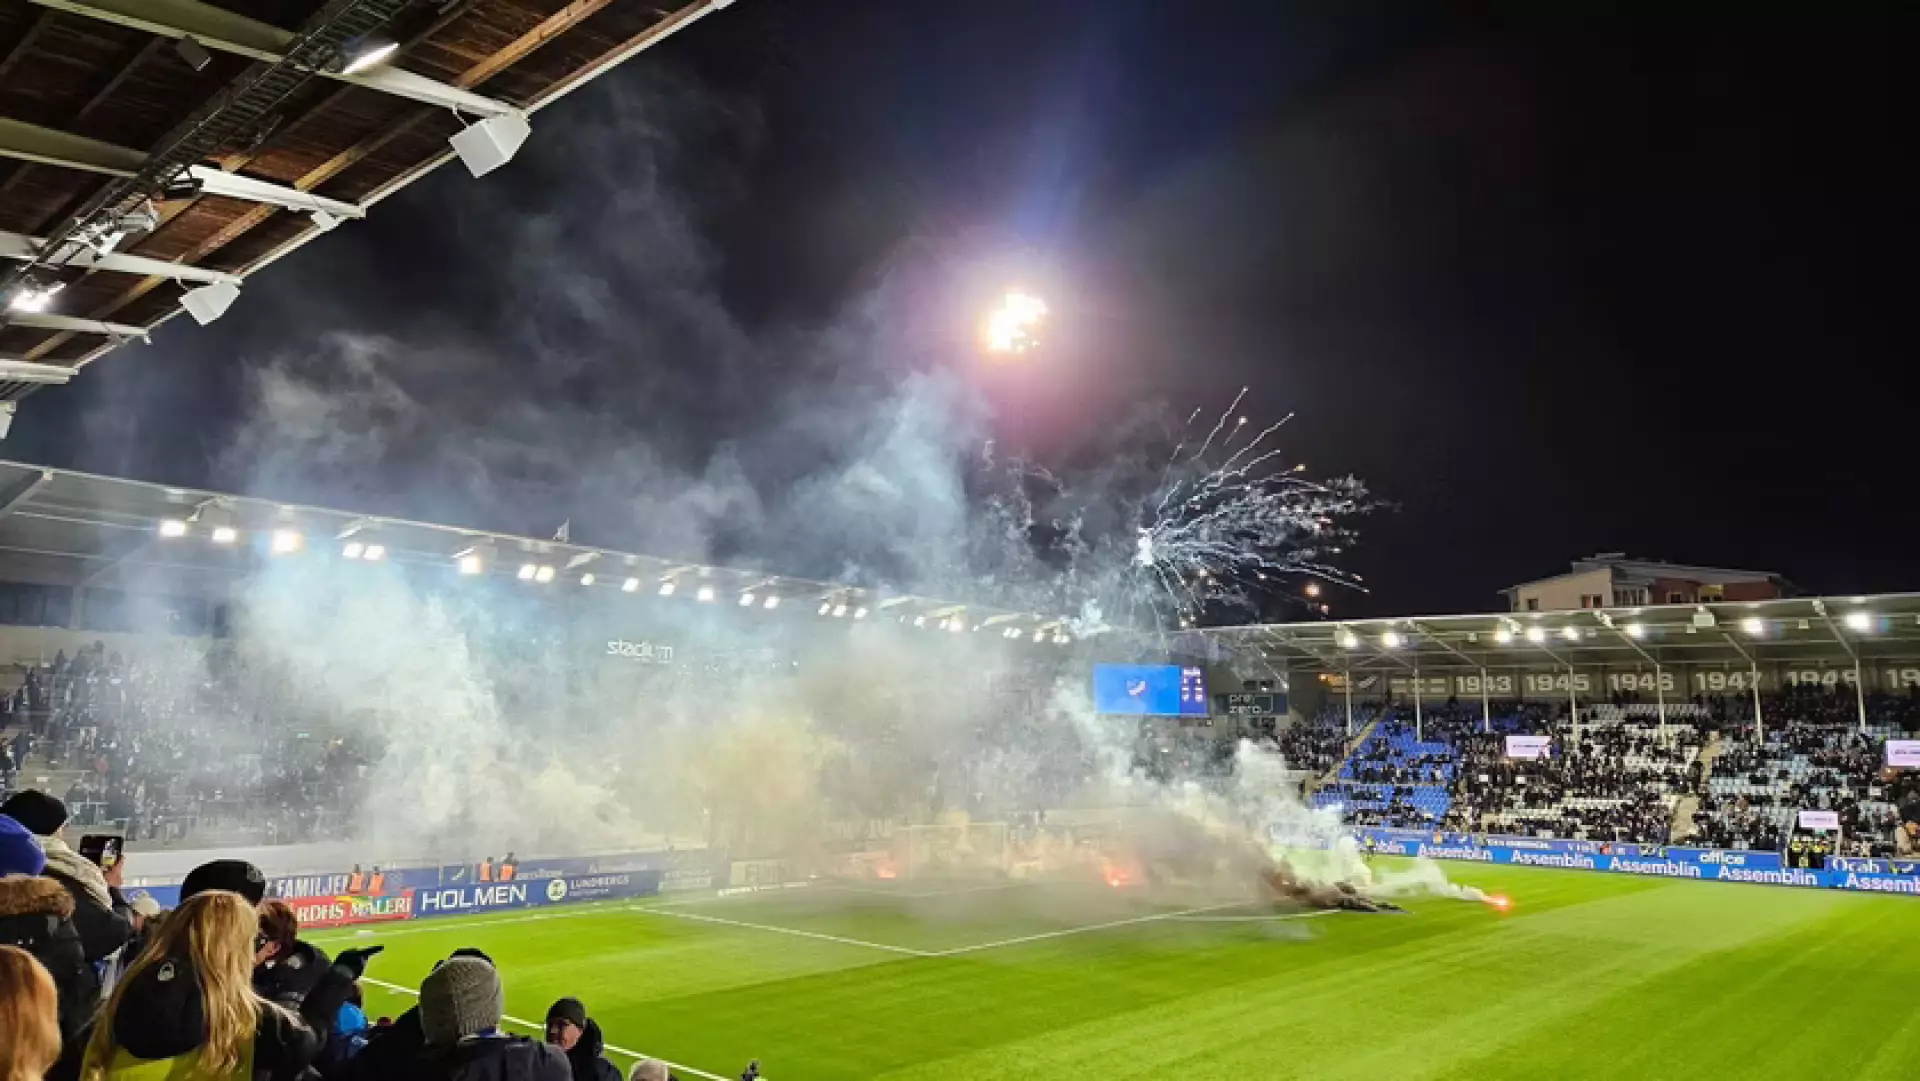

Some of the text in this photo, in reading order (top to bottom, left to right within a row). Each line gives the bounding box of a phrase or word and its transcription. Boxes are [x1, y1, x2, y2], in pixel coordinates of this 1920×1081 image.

[1456, 675, 1512, 692] 1943
[1527, 673, 1589, 692] 1945
[1696, 670, 1762, 691] 1947
[1511, 848, 1594, 869] Assemblin
[1609, 856, 1700, 877] Assemblin
[1699, 850, 1745, 865] office
[1718, 863, 1818, 886] Assemblin
[421, 884, 527, 911] HOLMEN
